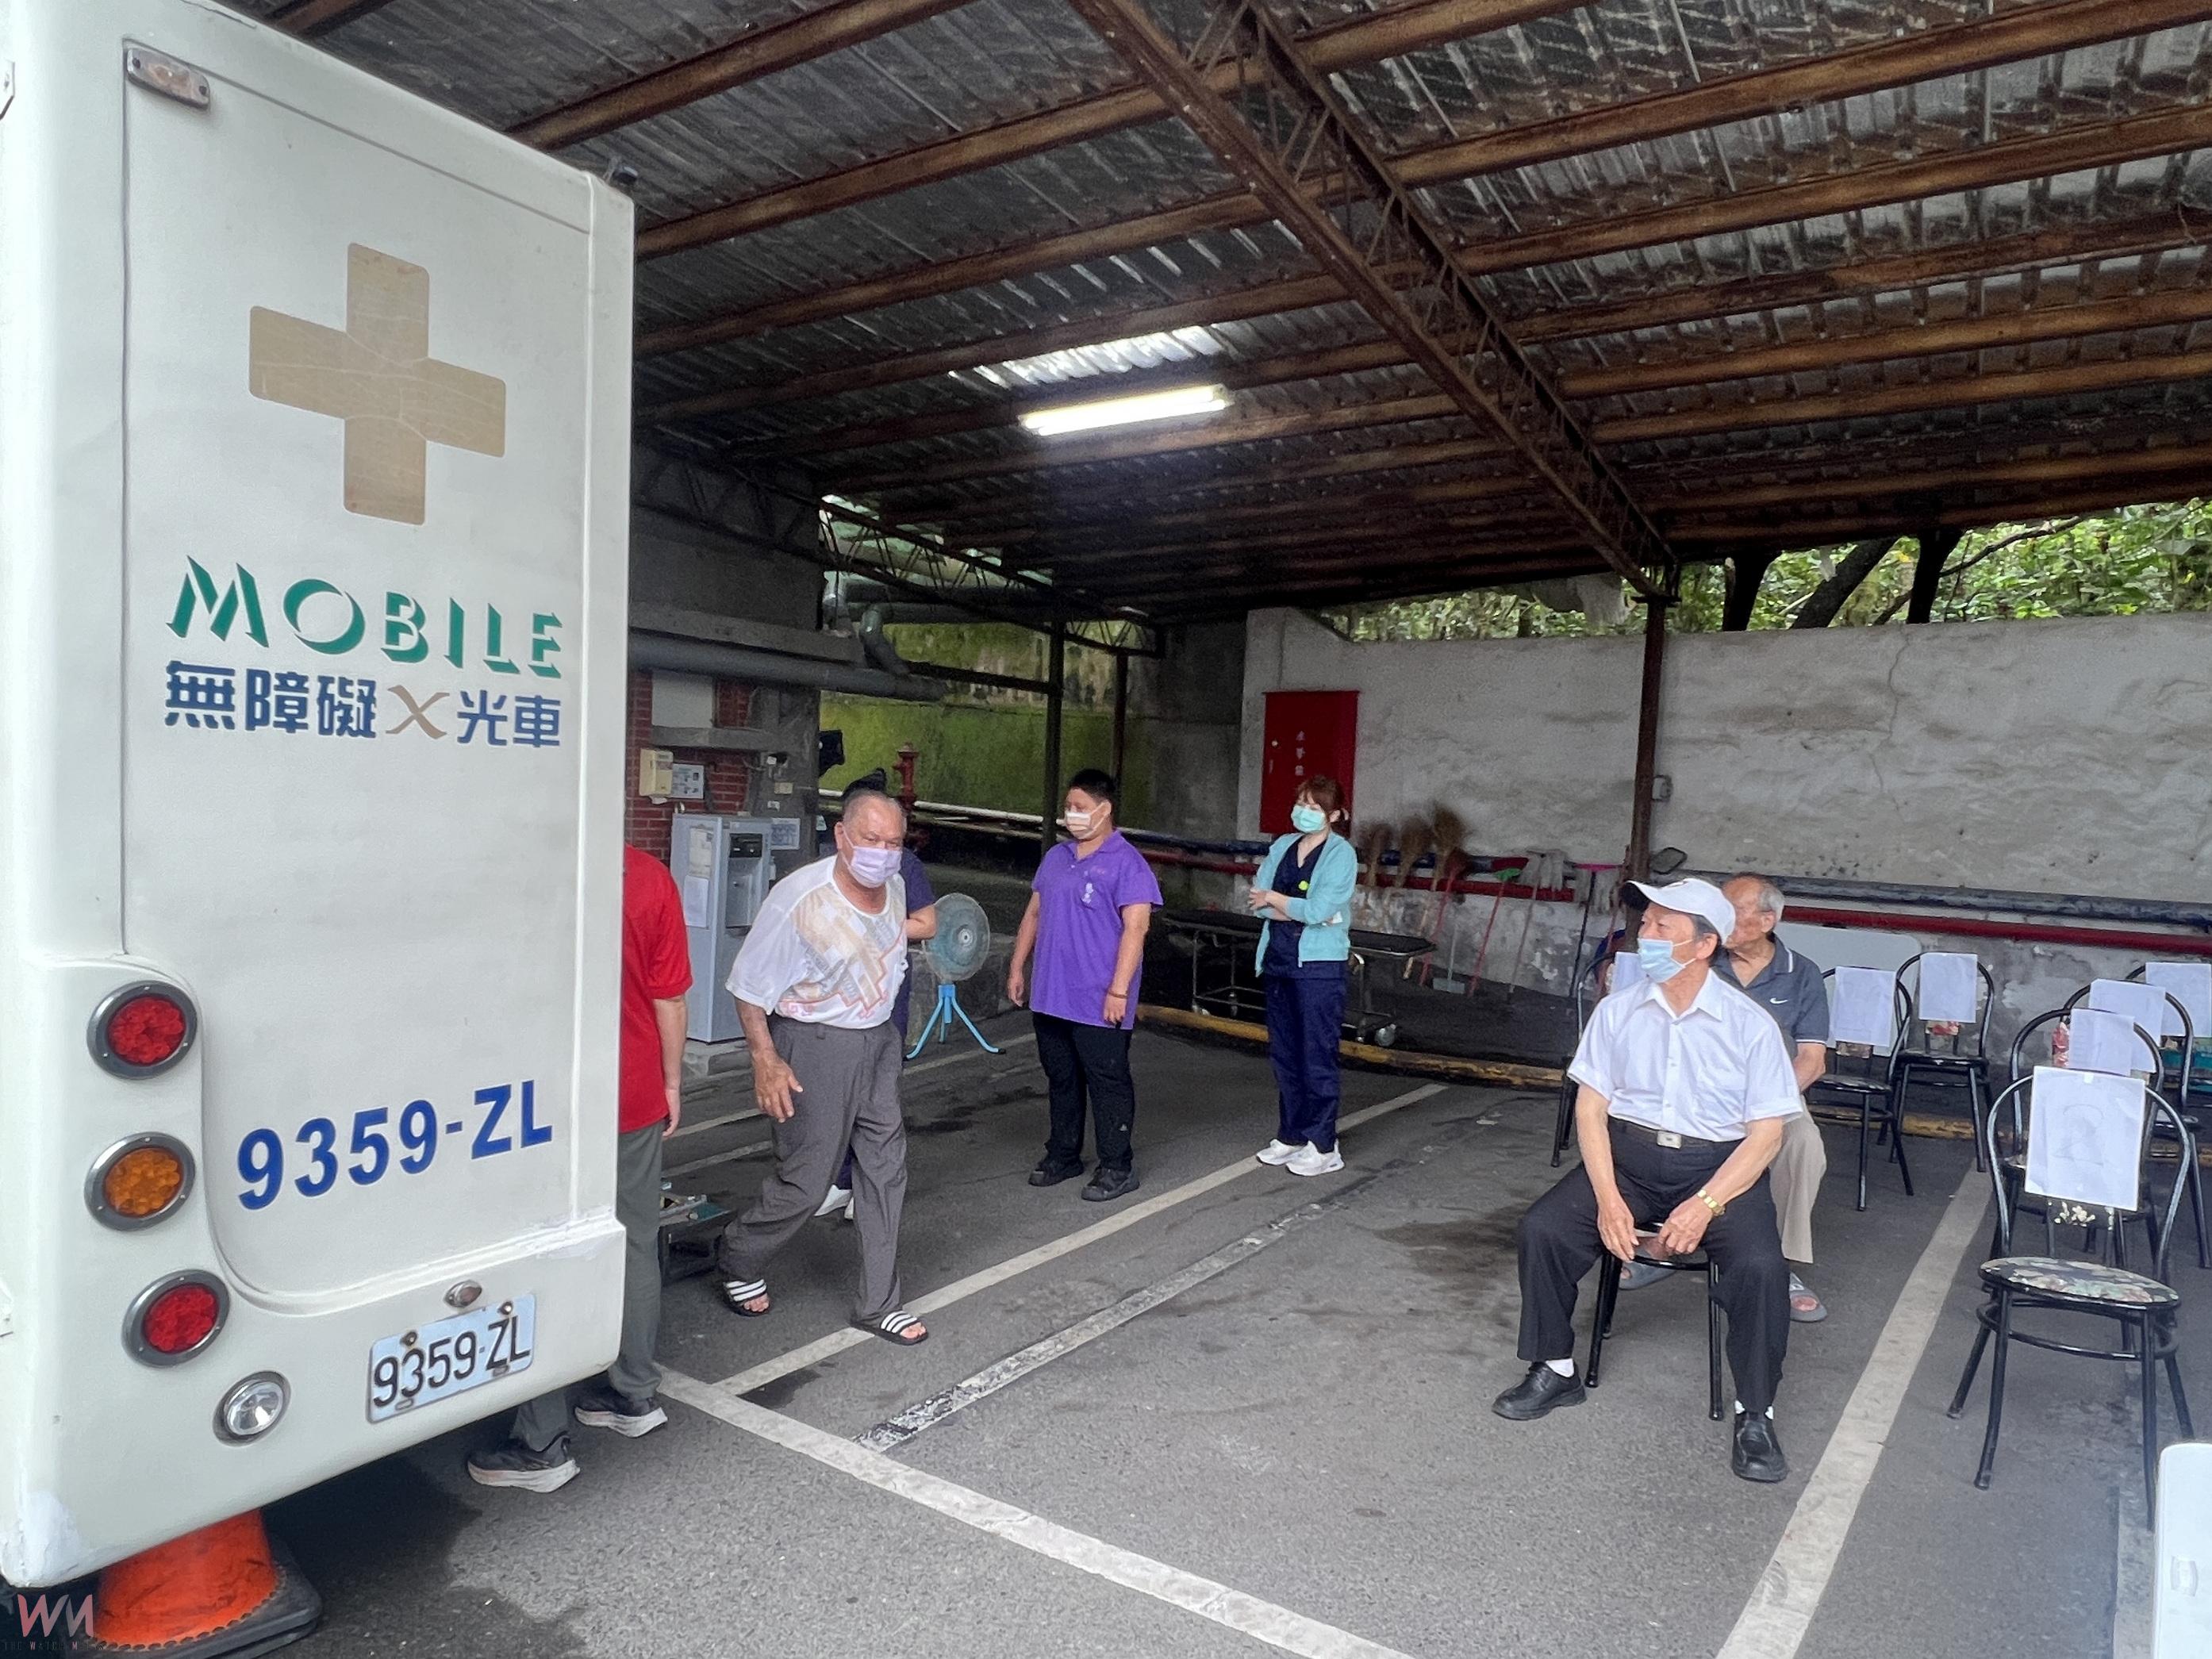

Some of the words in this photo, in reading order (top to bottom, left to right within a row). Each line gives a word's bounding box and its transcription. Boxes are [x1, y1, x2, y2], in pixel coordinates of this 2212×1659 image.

[166, 555, 563, 679] MOBILE
[237, 1080, 552, 1210] 9359-ZL
[372, 1315, 532, 1408] 9359-ZL
